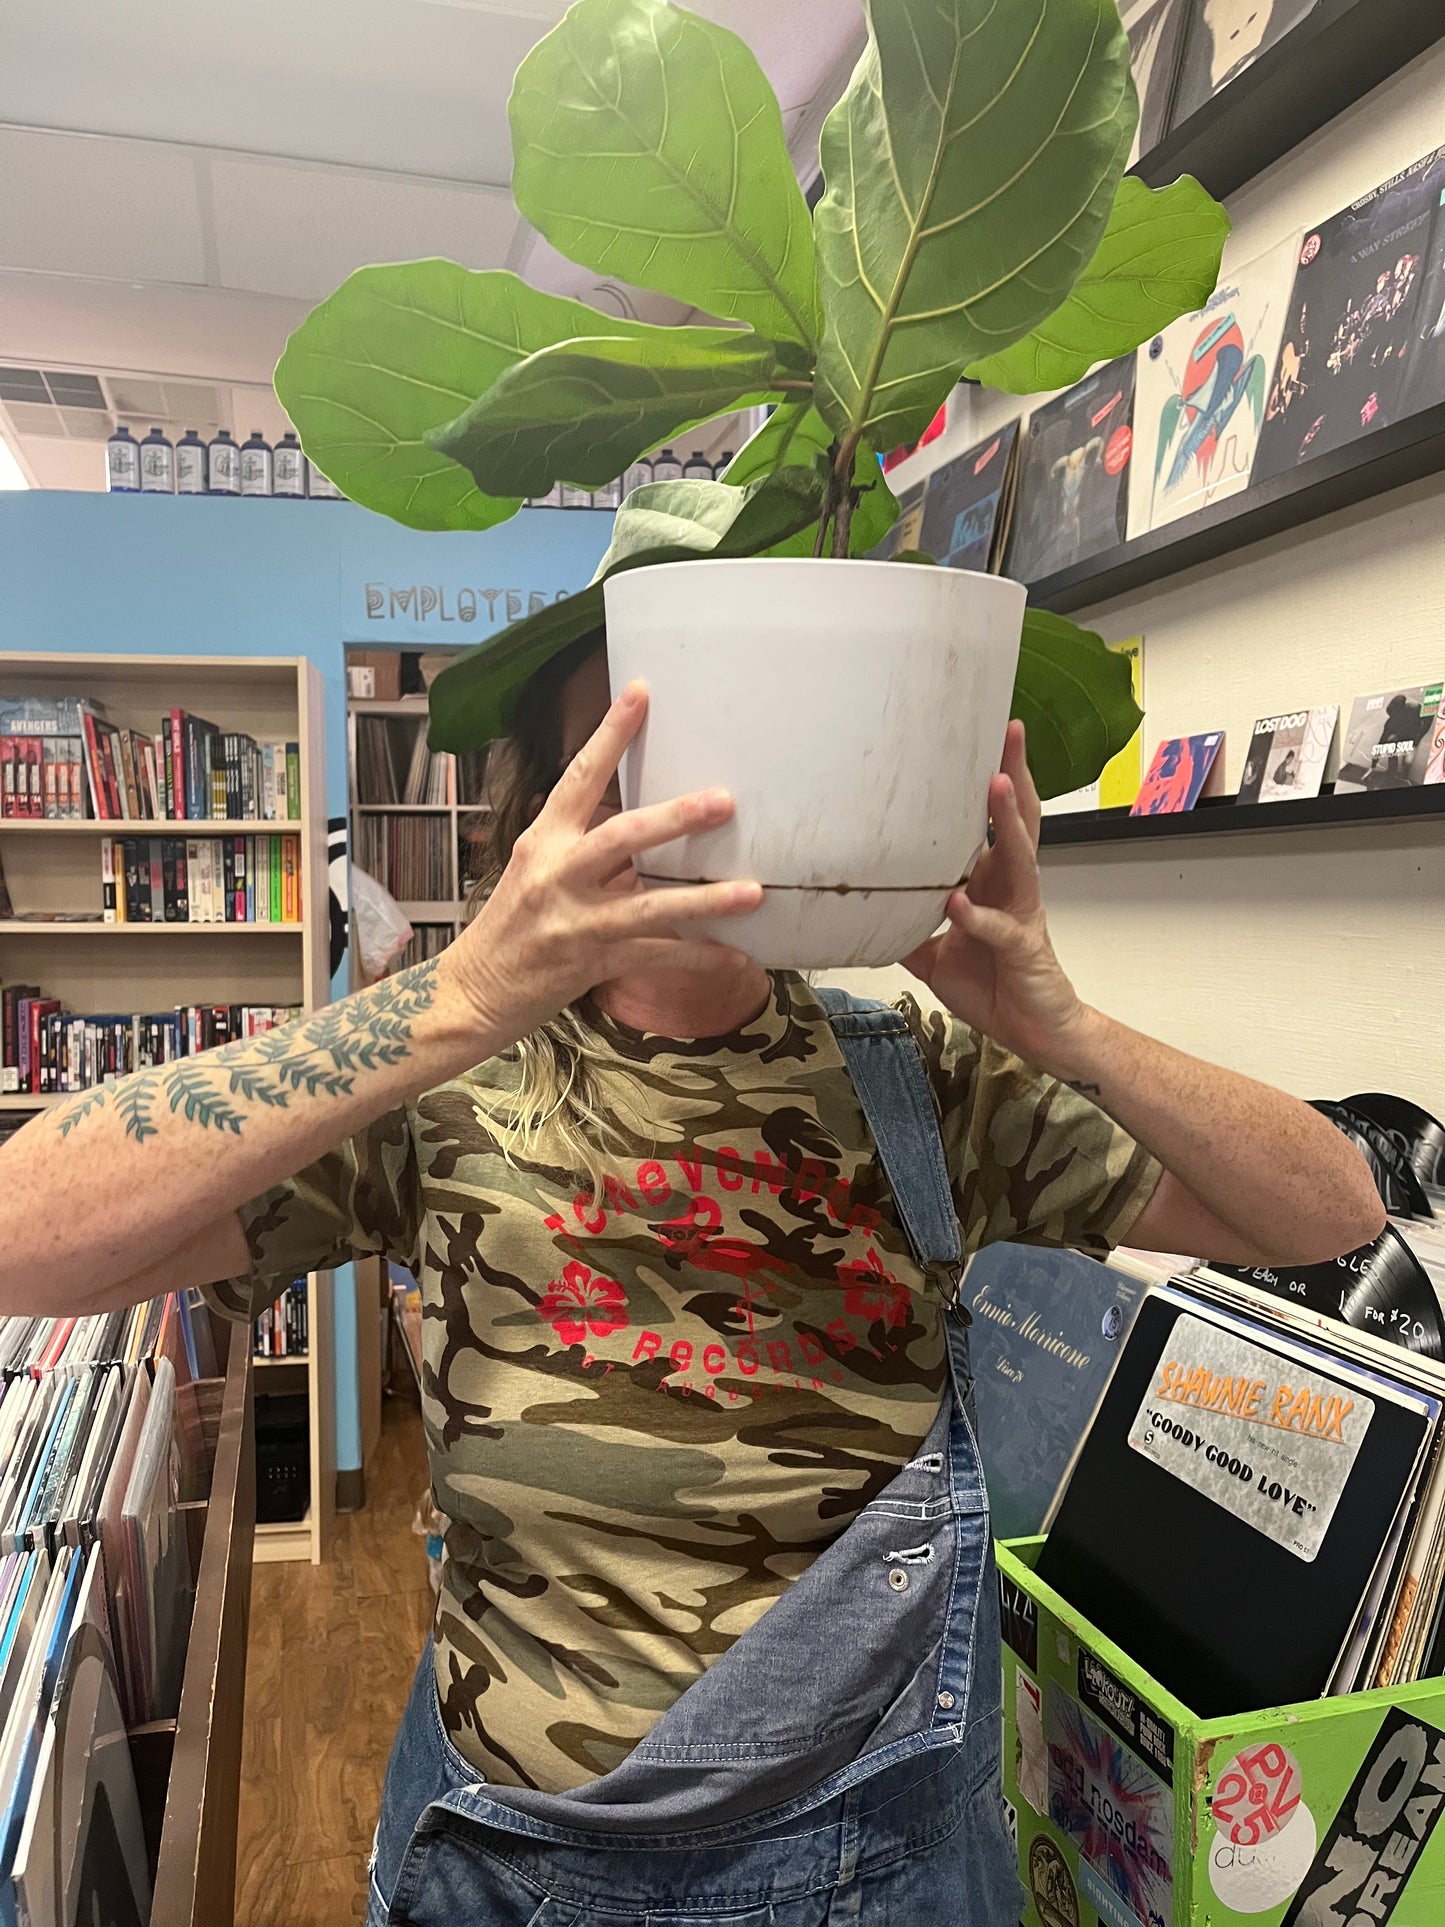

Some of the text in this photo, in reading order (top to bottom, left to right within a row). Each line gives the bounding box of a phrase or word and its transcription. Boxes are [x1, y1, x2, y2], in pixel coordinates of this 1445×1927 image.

[1358, 241, 1381, 259] WAY
[10, 719, 58, 732] AVENGERS
[1254, 711, 1307, 736] LOST DOG
[1371, 742, 1396, 756] STUPID
[1396, 740, 1414, 753] SOUL
[1289, 1281, 1306, 1297] OR
[1365, 1306, 1385, 1325] FOR
[1390, 1308, 1425, 1339] $20
[1012, 1311, 1091, 1370] Morricone
[1157, 1360, 1355, 1437] SHAWNIE RANX
[1205, 1445, 1253, 1482] GOOD
[1090, 1783, 1170, 1884] nosdam
